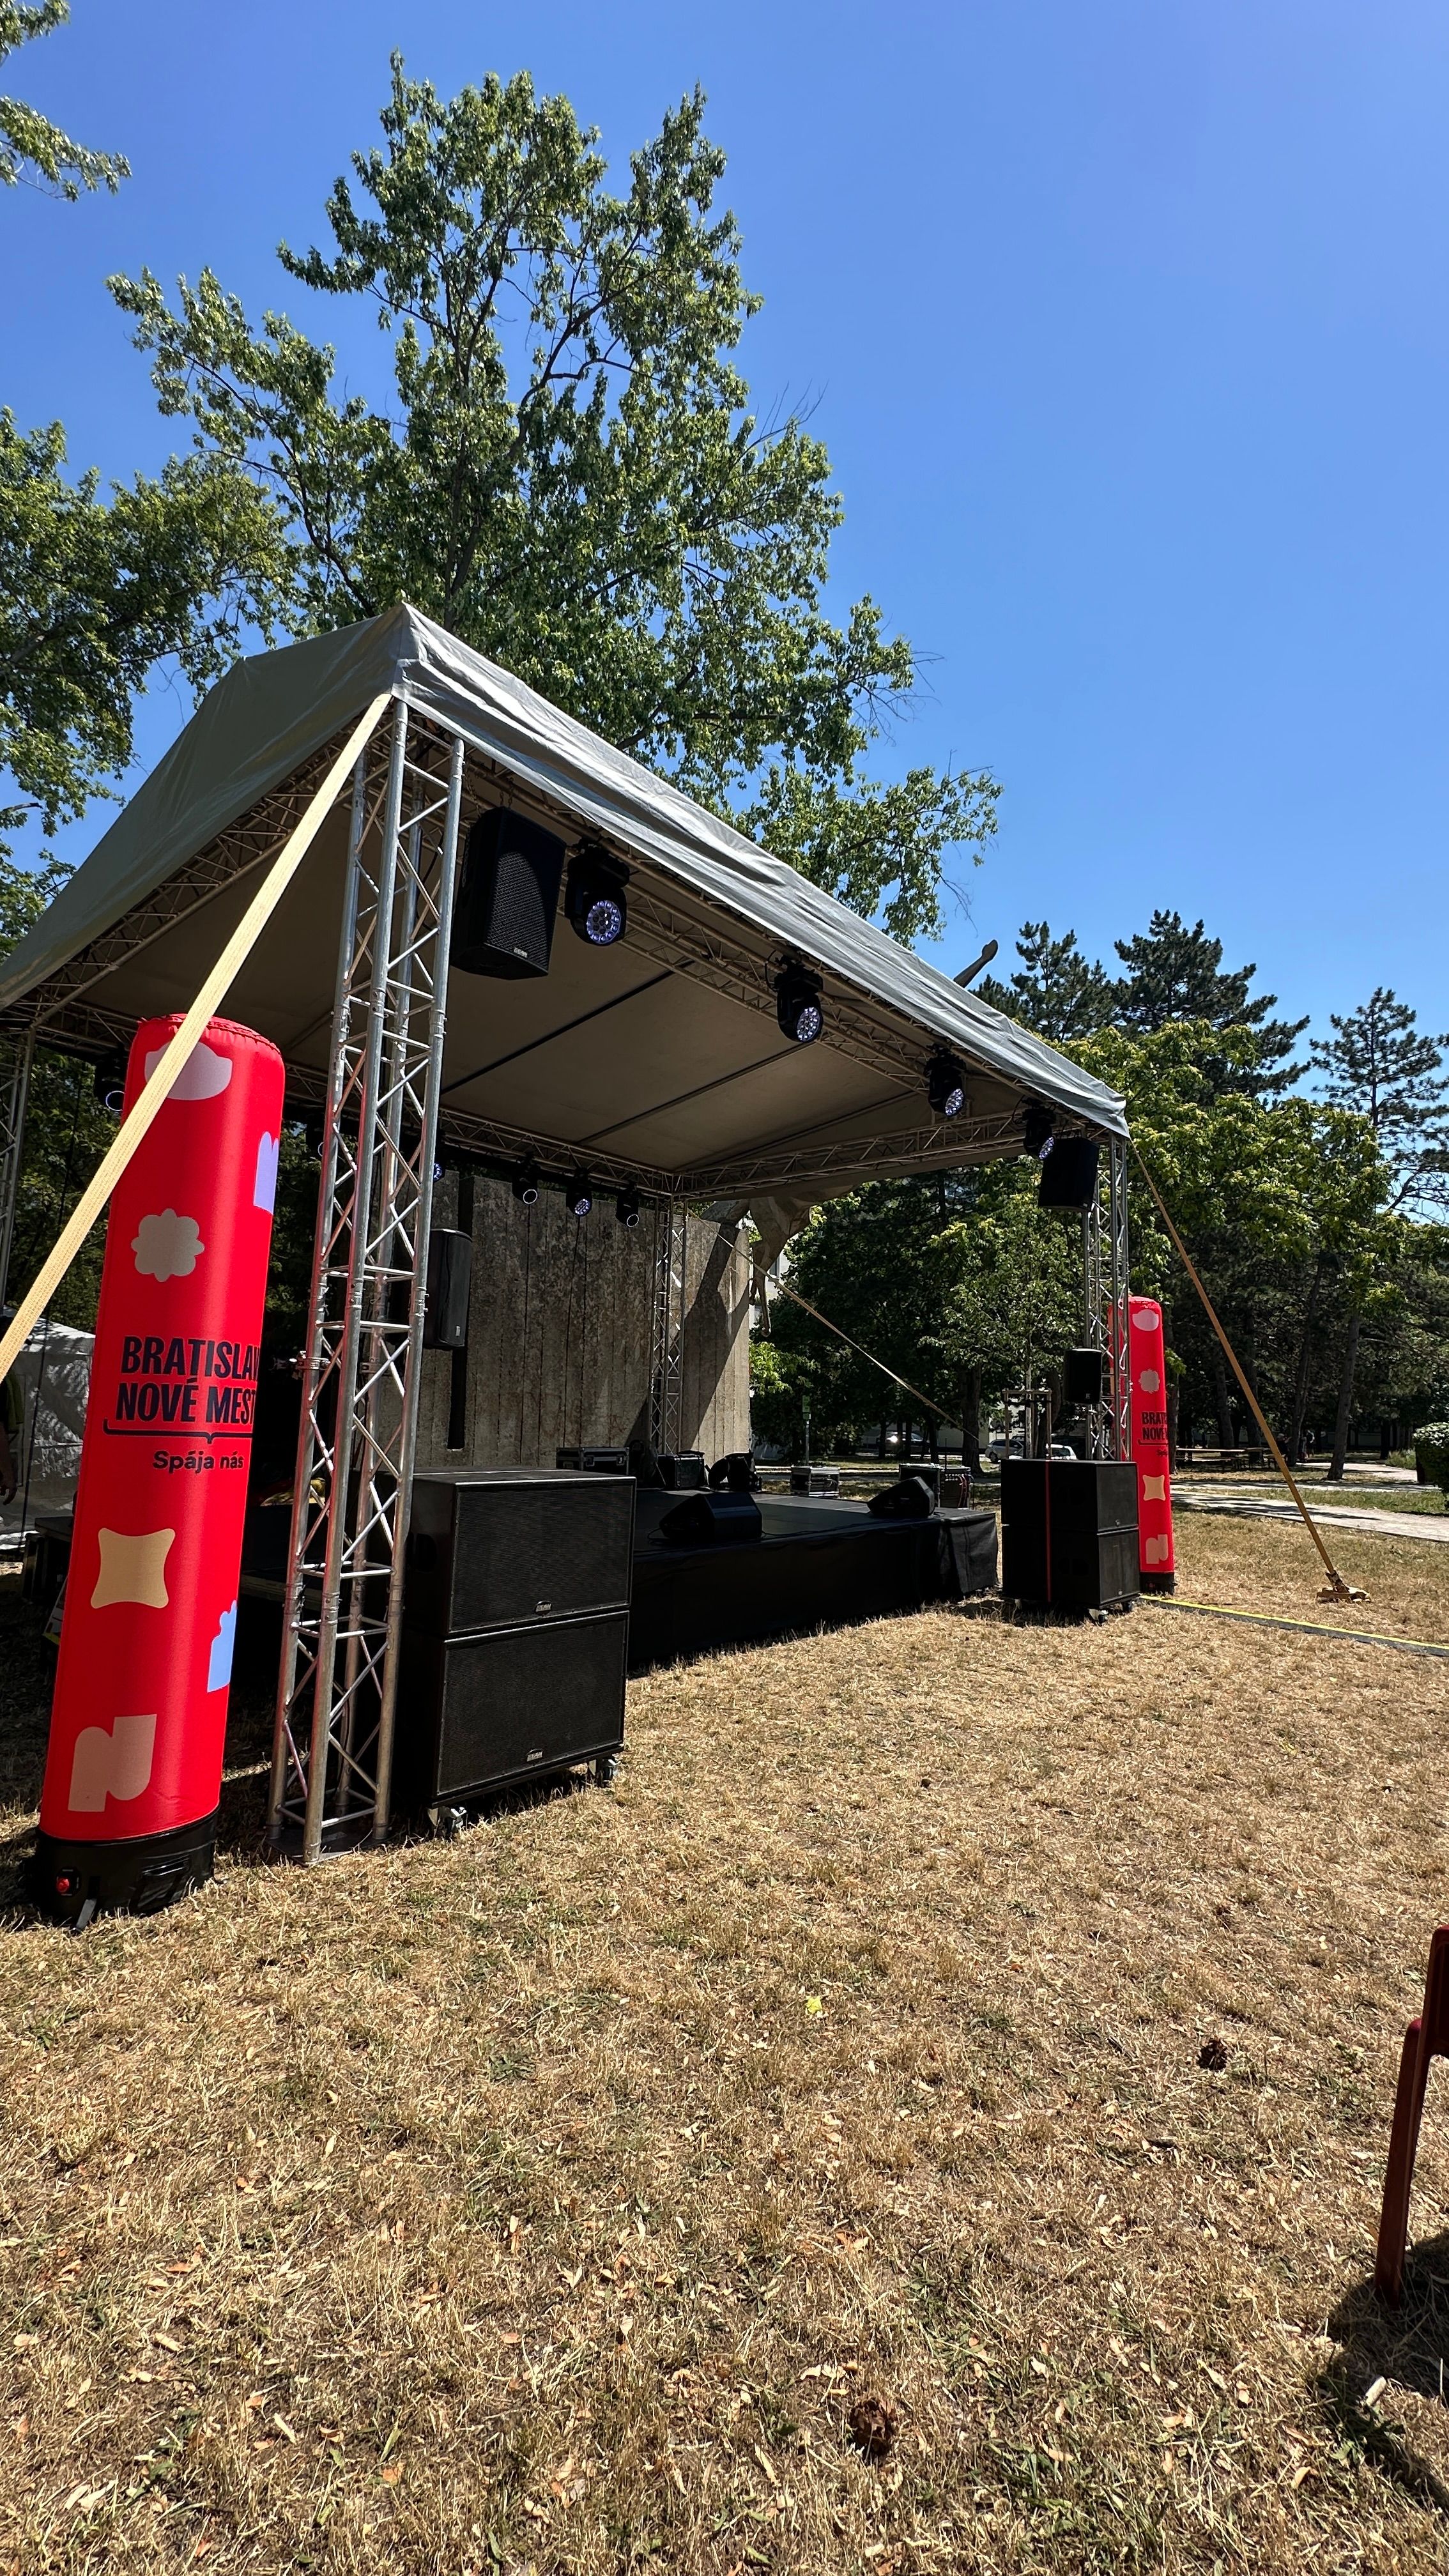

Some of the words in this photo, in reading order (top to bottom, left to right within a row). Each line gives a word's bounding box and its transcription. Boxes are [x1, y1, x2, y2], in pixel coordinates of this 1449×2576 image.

[116, 1377, 198, 1422] NOVÉ
[153, 1450, 215, 1474] Spája
[220, 1451, 244, 1469] nás
